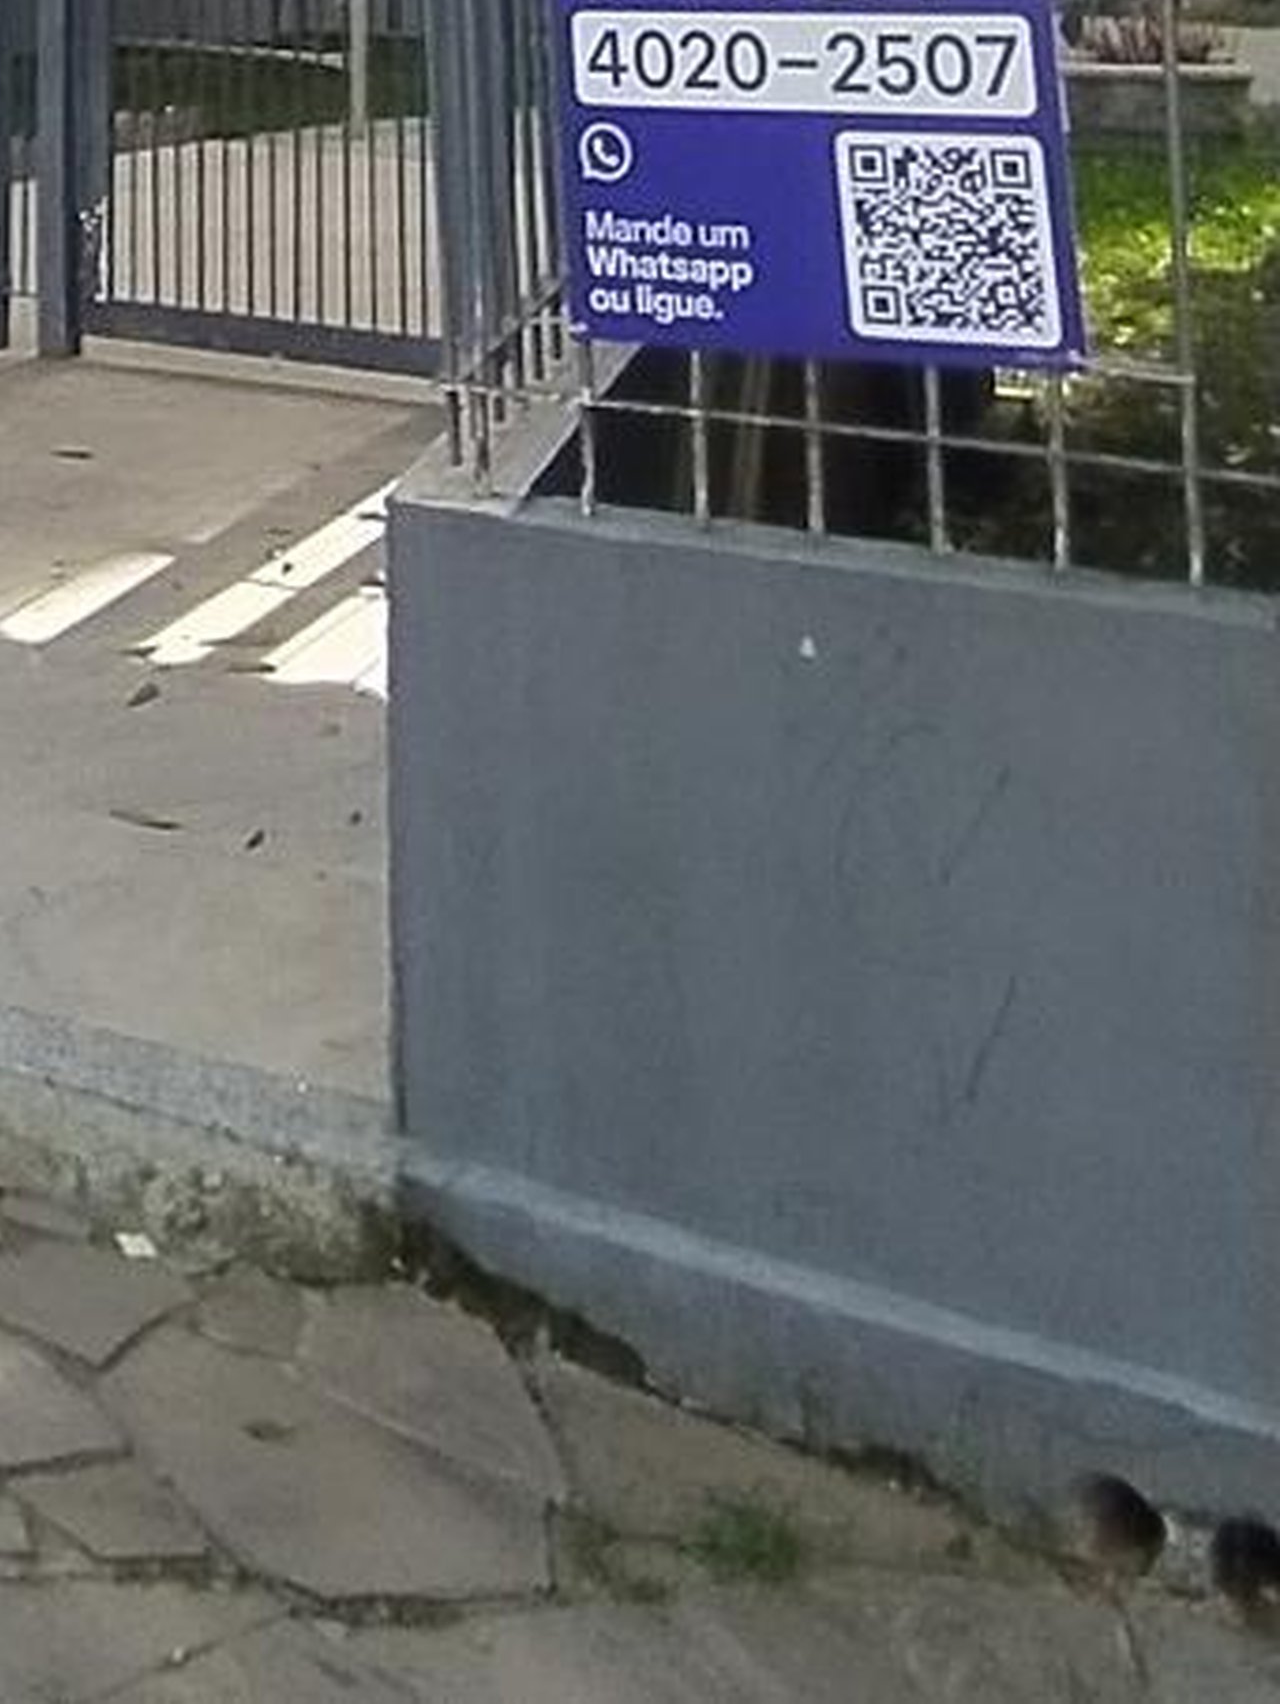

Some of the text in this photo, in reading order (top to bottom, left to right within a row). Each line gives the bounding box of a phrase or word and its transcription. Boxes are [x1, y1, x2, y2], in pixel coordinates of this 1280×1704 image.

[587, 29, 1018, 97] 4020-2507
[585, 210, 750, 250] Mande um
[586, 245, 753, 292] Whatsapp
[590, 284, 723, 324] ou ligue.
